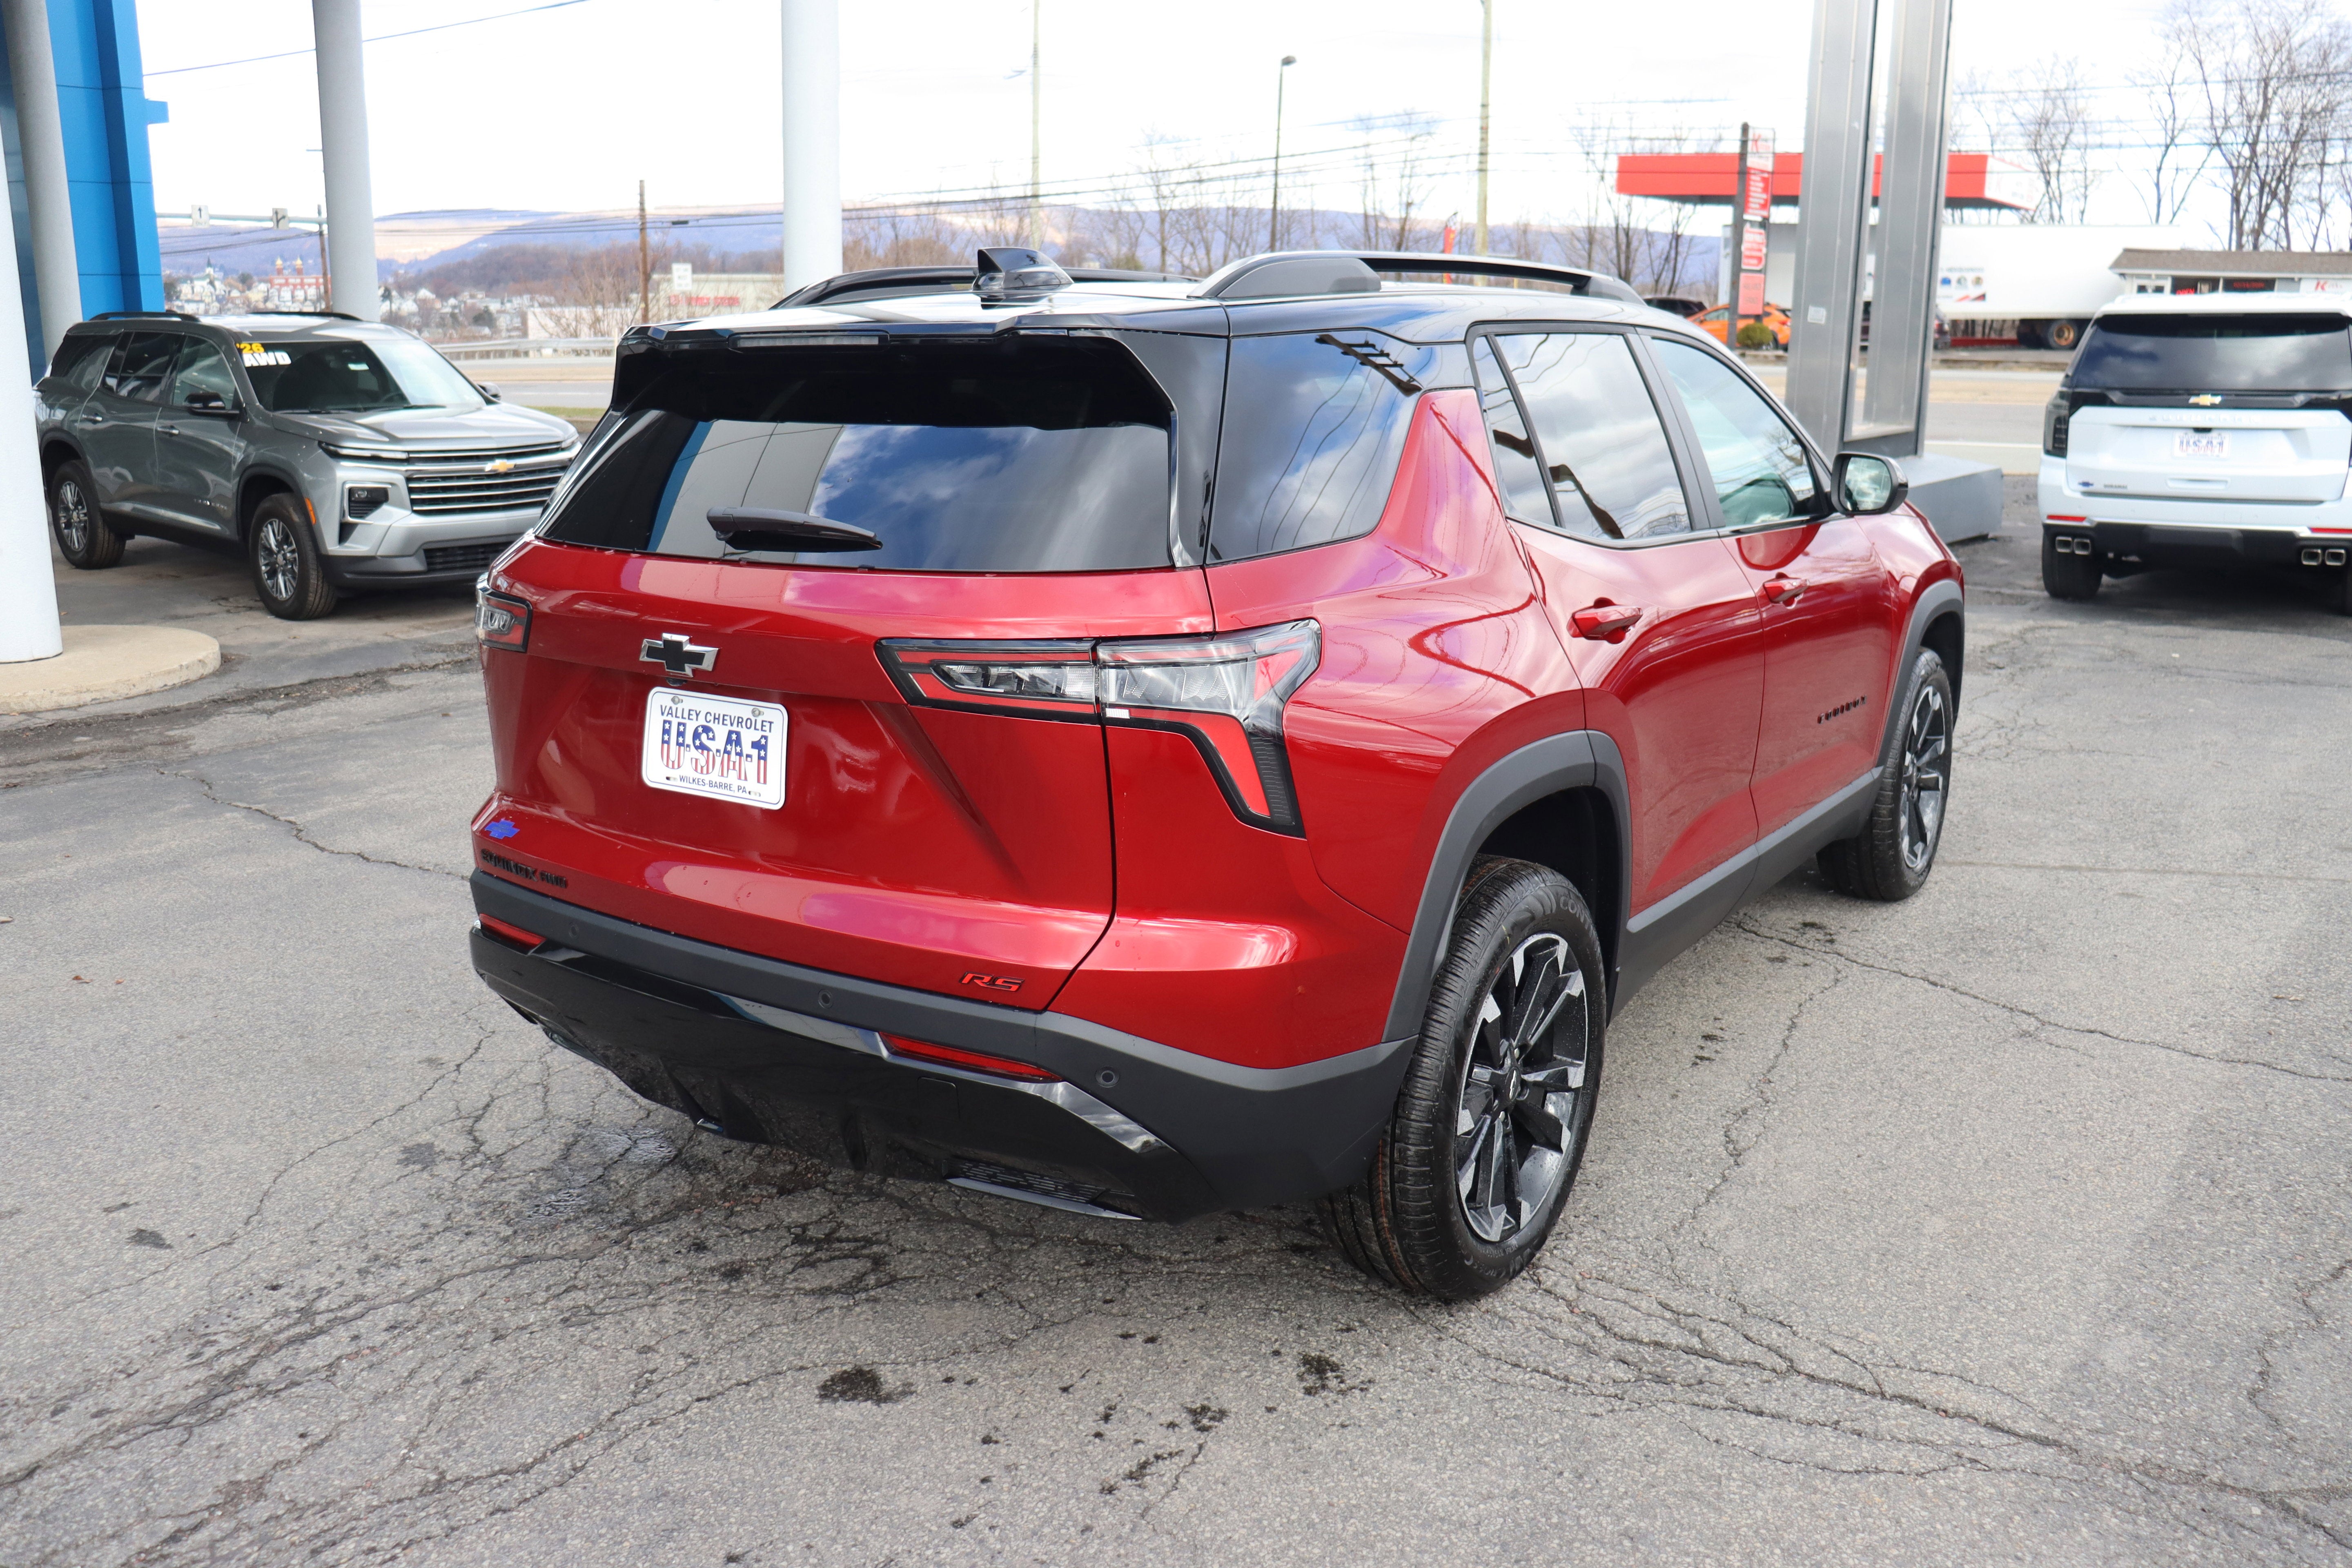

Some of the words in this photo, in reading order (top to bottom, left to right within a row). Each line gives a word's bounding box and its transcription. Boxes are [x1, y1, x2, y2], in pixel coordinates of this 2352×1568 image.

[236, 343, 264, 354] '26
[243, 351, 292, 367] AWD
[660, 704, 701, 721] VALLEY
[705, 711, 774, 733] CHEVROLET
[679, 775, 735, 793] WILKES-BARRE,
[737, 785, 747, 794] PA
[481, 848, 538, 882] EQUINOX
[959, 971, 1025, 992] RS
